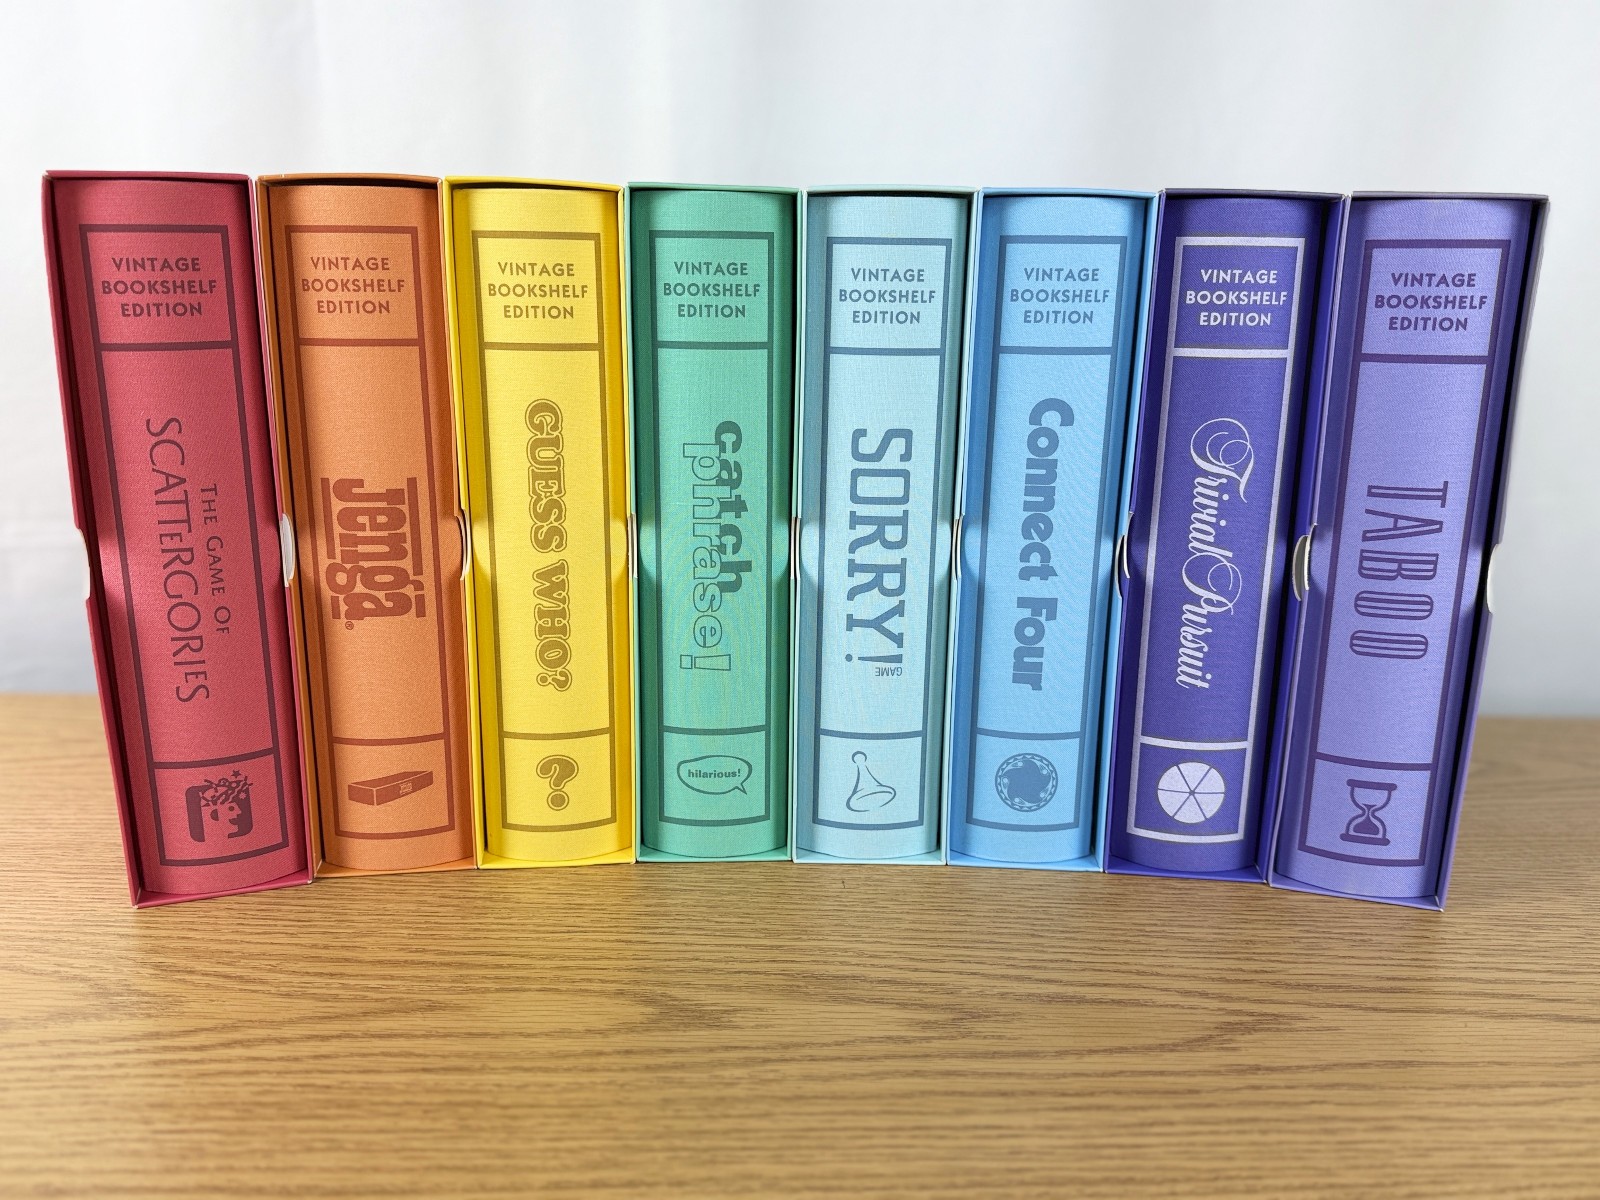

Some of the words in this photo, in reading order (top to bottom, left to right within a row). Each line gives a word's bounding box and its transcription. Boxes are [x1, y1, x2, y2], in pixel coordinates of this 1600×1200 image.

[111, 256, 201, 272] VINTAGE
[309, 256, 391, 272] VINTAGE
[497, 262, 576, 278] VINTAGE
[673, 261, 749, 276] VINTAGE
[850, 268, 926, 283] VINTAGE
[1023, 267, 1099, 283] VINTAGE
[1200, 268, 1278, 285] VINTAGE
[1390, 272, 1477, 289] VINTAGE
[101, 279, 218, 296] BOOKSHELF
[301, 278, 406, 294] BOOKSHELF
[487, 283, 589, 299] BOOKSHELF
[662, 282, 761, 298] BOOKSHELF
[838, 289, 937, 304] BOOKSHELF
[1010, 288, 1111, 304] BOOKSHELF
[1185, 290, 1288, 306] BOOKSHELF
[1374, 293, 1488, 311] BOOKSHELF
[120, 300, 203, 318] EDITION
[316, 298, 391, 314] EDITION
[502, 304, 575, 319] EDITION
[678, 303, 746, 319] EDITION
[852, 310, 922, 325] EDITION
[1023, 309, 1095, 324] EDITION
[1198, 311, 1272, 327] EDITION
[1388, 315, 1469, 333] EDITION
[525, 398, 569, 553] GUESS
[1018, 397, 1075, 582] Connect
[1187, 417, 1255, 561] Trivial
[200, 484, 217, 526] THE
[714, 420, 752, 594] catch
[845, 427, 913, 664] SORRY!
[679, 442, 732, 672] phrase!
[206, 535, 226, 597] GAME
[1349, 480, 1448, 660] TABOO
[213, 606, 231, 635] OF
[533, 560, 573, 692] WHO?
[1176, 550, 1242, 690] Pursuit
[1012, 597, 1058, 691] Four
[874, 666, 903, 677] GAME
[687, 767, 741, 779] hilarious!
